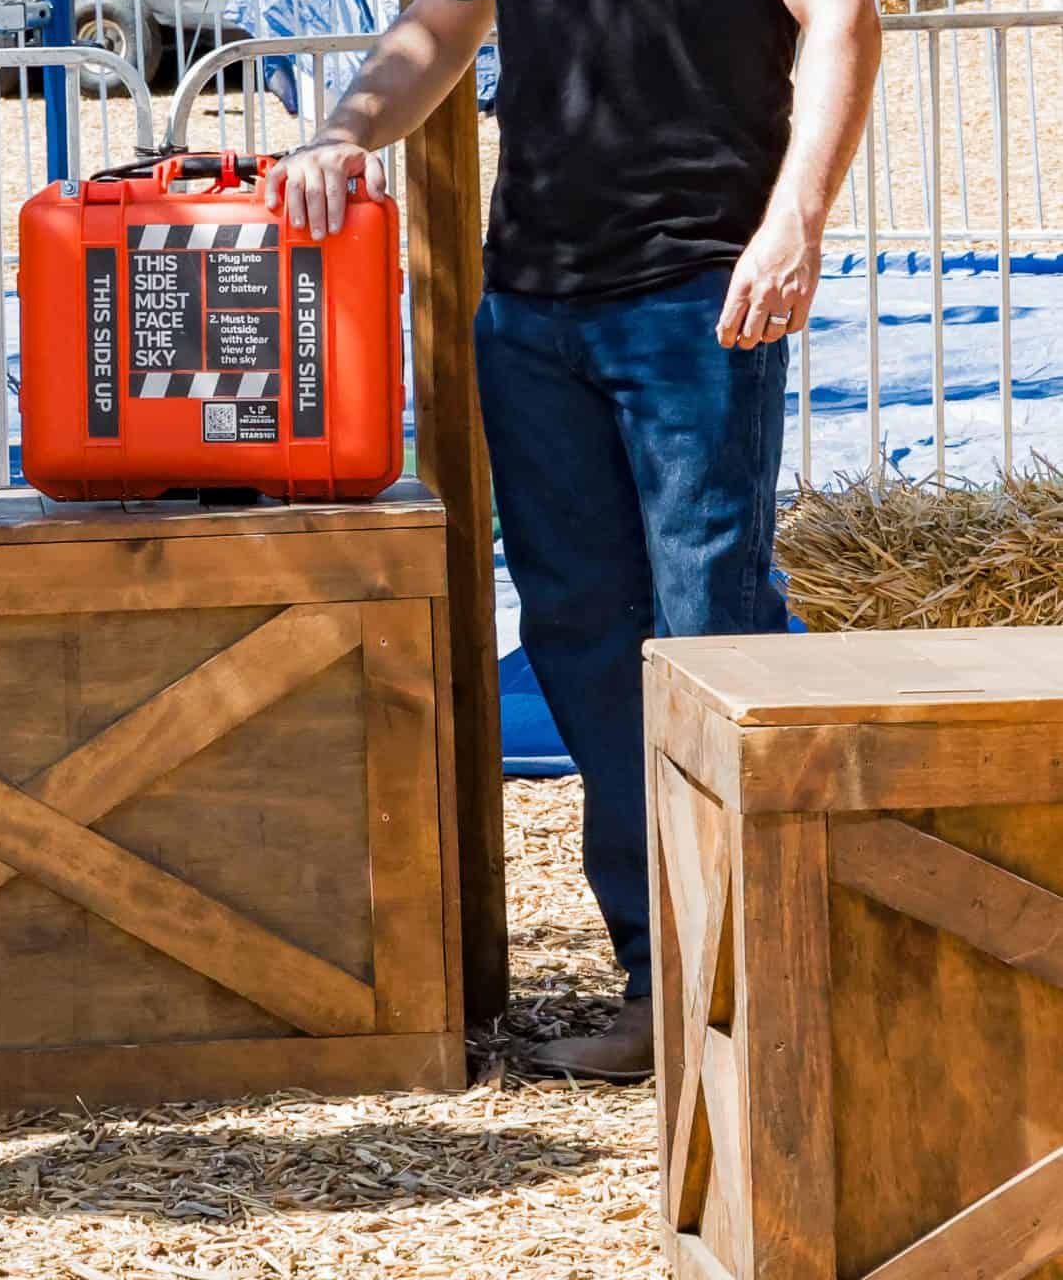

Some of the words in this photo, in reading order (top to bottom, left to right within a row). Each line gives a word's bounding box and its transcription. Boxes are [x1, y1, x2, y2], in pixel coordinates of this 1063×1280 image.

[133, 255, 178, 272] THIS
[218, 254, 241, 266] Plug
[242, 254, 262, 263] into
[218, 264, 250, 274] power
[134, 274, 178, 291] SIDE
[218, 274, 248, 283] outlet
[218, 285, 230, 294] or
[231, 284, 269, 295] battery
[298, 272, 316, 303] UP
[93, 274, 111, 323] THIS
[134, 293, 190, 310] MUST
[134, 311, 184, 329] FACE
[220, 314, 244, 324] Must
[247, 314, 260, 324] be
[220, 324, 258, 334] outside
[298, 308, 316, 358] SIDE
[134, 331, 173, 348] THE
[220, 334, 243, 345] with
[244, 334, 269, 345] clear
[94, 328, 112, 377] SIDE
[220, 344, 244, 354] view
[245, 344, 257, 354] of
[134, 349, 177, 367] SKY
[220, 354, 237, 364] the
[239, 354, 257, 366] sky
[298, 363, 317, 412] THIS
[94, 383, 112, 413] UP
